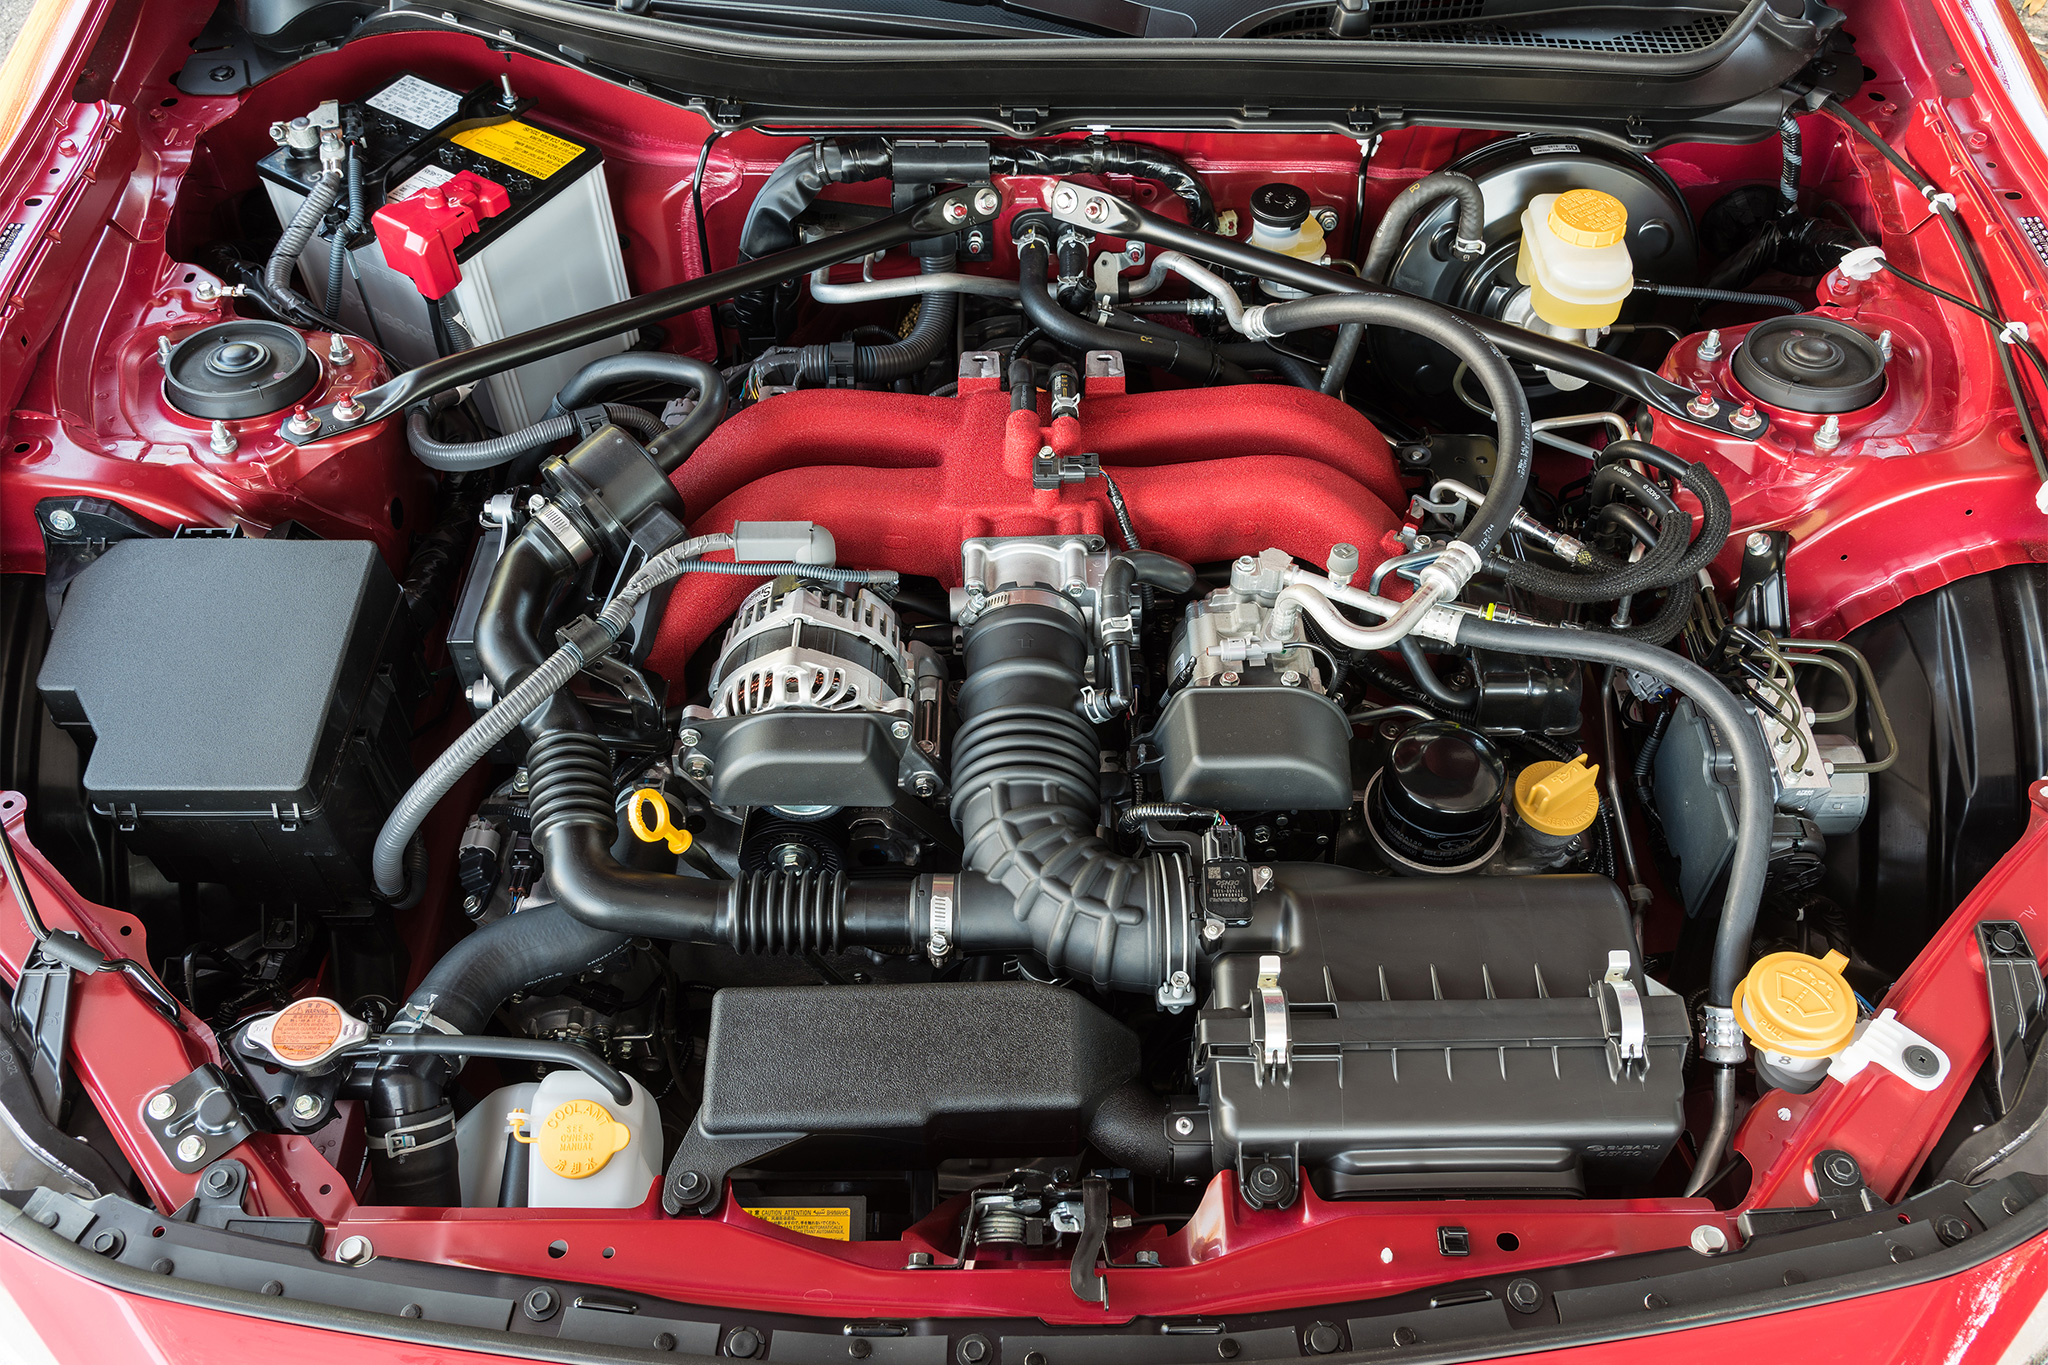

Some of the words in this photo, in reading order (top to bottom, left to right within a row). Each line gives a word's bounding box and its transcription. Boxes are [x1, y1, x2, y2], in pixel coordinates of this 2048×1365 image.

[1518, 764, 1540, 792] ENGINE
[1547, 817, 1560, 826] SEE
[1423, 843, 1477, 857] SUBARU
[1759, 1019, 1783, 1041] PULL
[1778, 1055, 1792, 1065] 8
[547, 1103, 610, 1129] COOLANT
[566, 1124, 584, 1133] SEE
[560, 1133, 594, 1143] OWNERS
[559, 1142, 593, 1152] MANUAL
[554, 1157, 598, 1175] 冷却水
